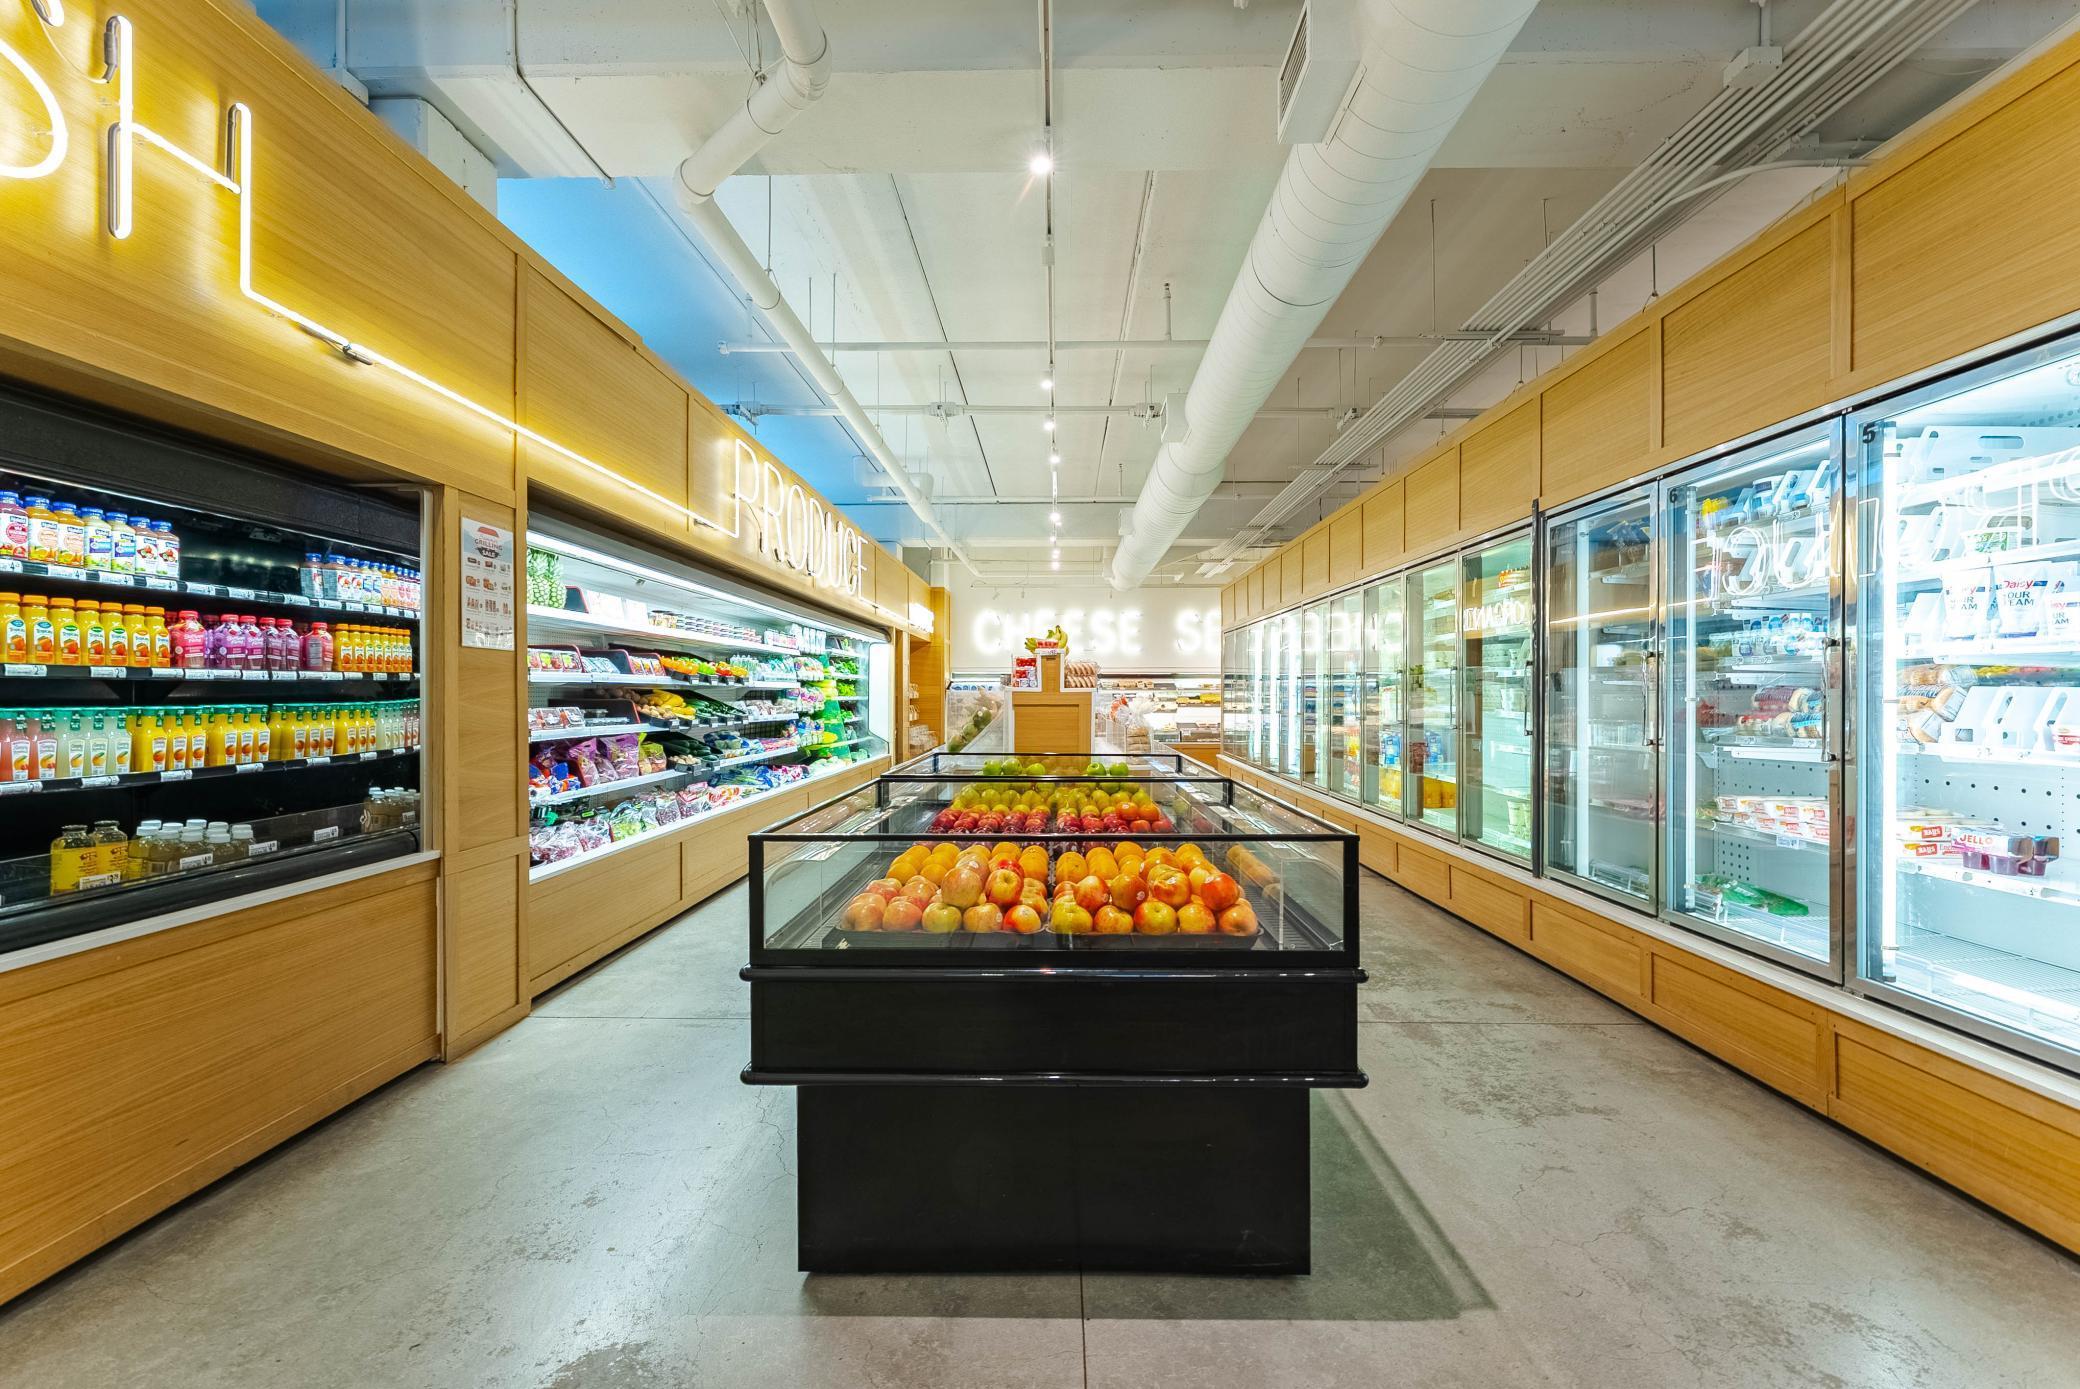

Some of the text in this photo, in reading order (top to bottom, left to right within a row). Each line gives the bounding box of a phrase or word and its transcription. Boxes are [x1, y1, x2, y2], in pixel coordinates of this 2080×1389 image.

[1862, 423, 1877, 444] 5
[1669, 487, 1679, 504] 6
[734, 438, 869, 602] PRODUCE
[974, 607, 1143, 654] CHEESE
